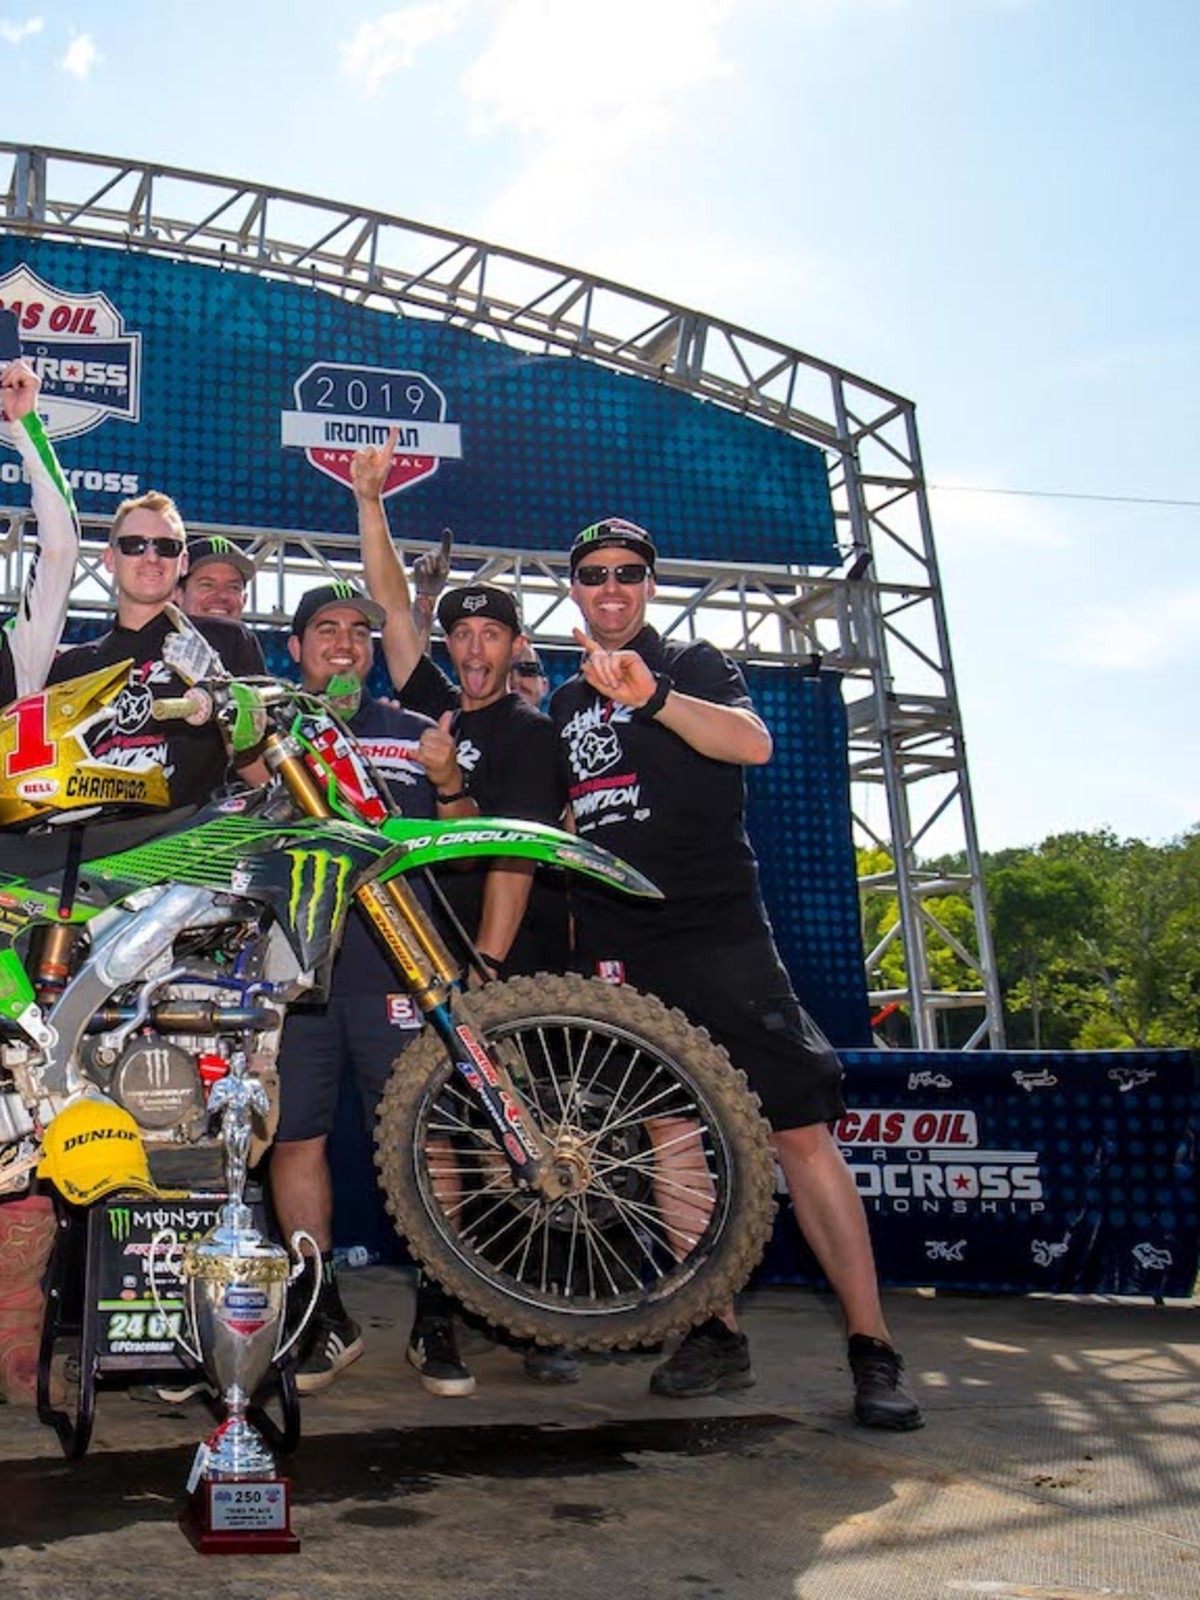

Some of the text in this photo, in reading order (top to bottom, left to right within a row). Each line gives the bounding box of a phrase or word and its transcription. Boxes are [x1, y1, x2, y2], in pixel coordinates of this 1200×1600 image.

[49, 306, 97, 334] OIL
[315, 377, 425, 414] 2019
[324, 451, 424, 468] NANAL
[3, 693, 58, 777] 1
[24, 781, 54, 794] BELL
[66, 775, 147, 799] CHAMPION
[402, 829, 538, 851] RO CIRCUIT
[63, 1127, 138, 1152] DUNLOP
[834, 1112, 970, 1144] CAS OIL
[842, 1148, 923, 1162] PRO
[854, 1164, 1044, 1199] OCROSS
[133, 1208, 221, 1230] MONST
[875, 1200, 1046, 1214] IONSHIP
[108, 1312, 145, 1340] 24
[235, 1491, 261, 1503] 250
